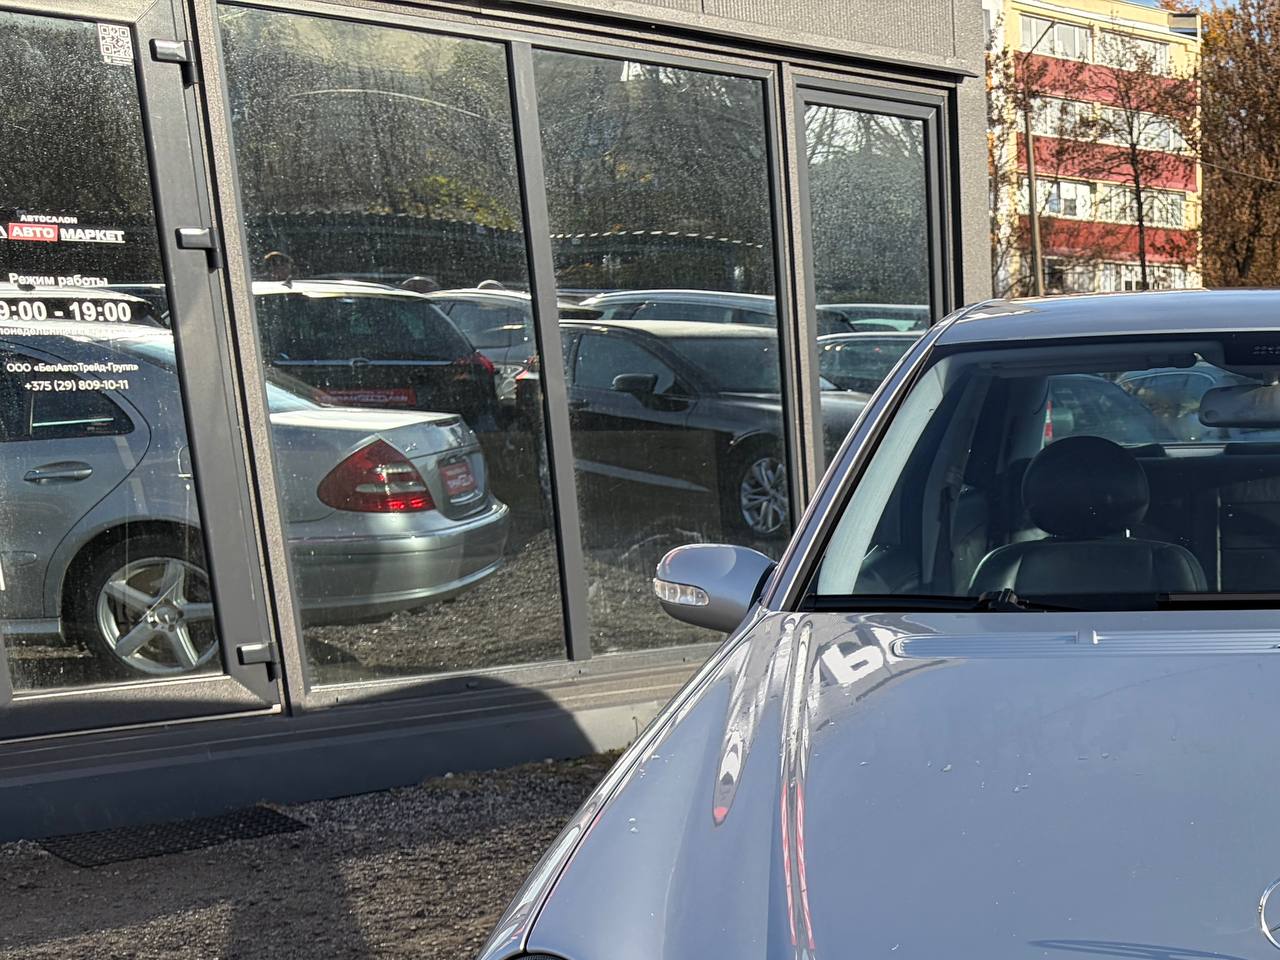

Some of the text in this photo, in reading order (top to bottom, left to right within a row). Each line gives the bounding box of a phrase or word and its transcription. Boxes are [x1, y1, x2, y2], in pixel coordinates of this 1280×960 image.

[20, 214, 78, 224] АВТОСАЛОН
[9, 273, 109, 288] Режим работы
[69, 302, 132, 322] 19:00
[6, 363, 31, 373] ООО
[24, 380, 129, 392] +375 (29) 809-10-11
